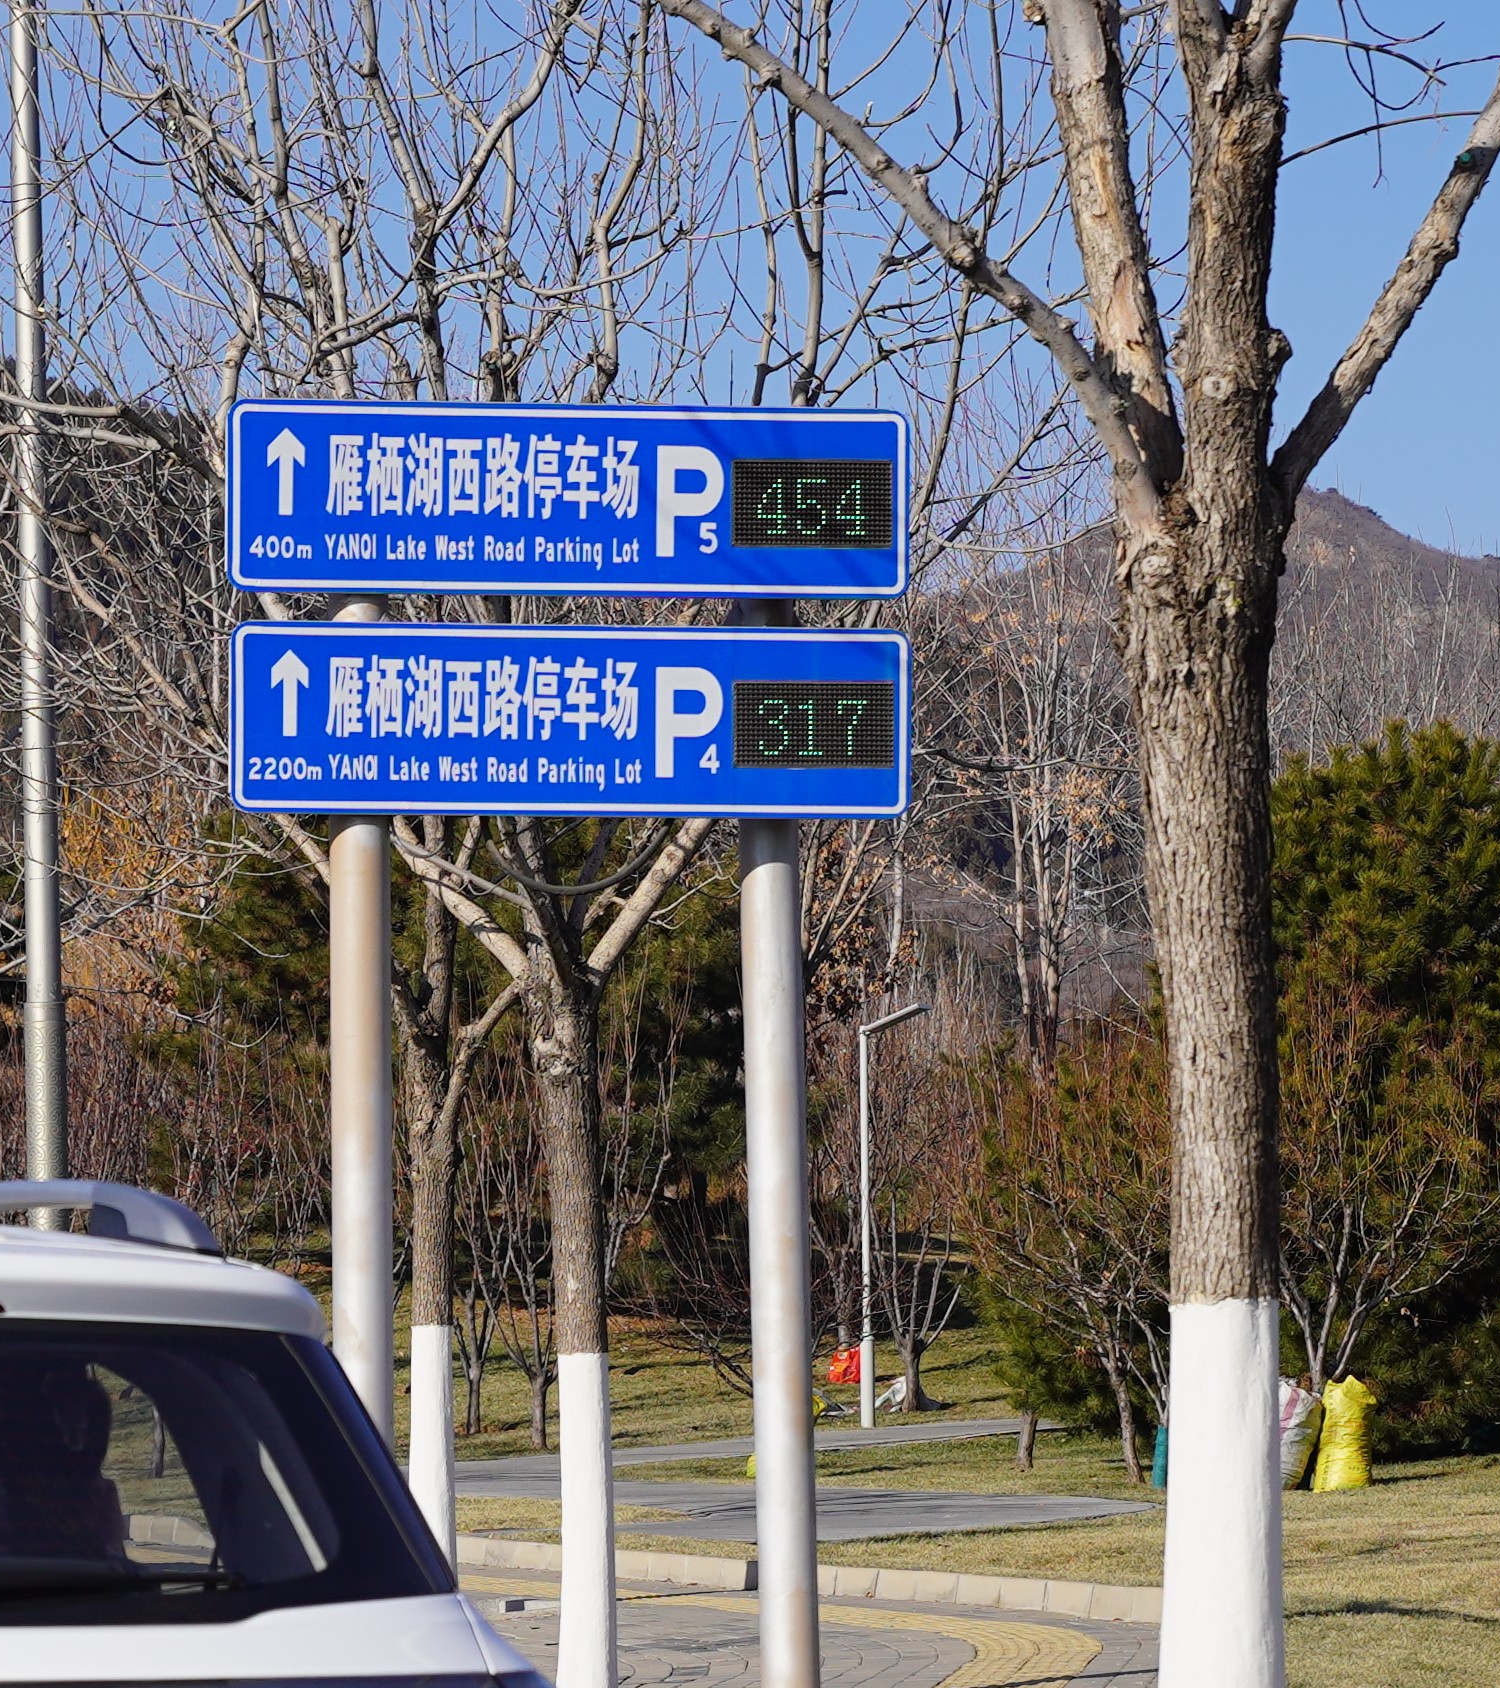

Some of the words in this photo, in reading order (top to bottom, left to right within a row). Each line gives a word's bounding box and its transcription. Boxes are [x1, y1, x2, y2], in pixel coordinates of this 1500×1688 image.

[325, 432, 640, 520] 雁栖湖西路停车场
[756, 478, 866, 536] 454
[248, 534, 313, 560] 400m
[324, 533, 377, 560] YANQI
[386, 533, 427, 561] Lake
[435, 534, 475, 562] West
[483, 535, 525, 562] Road
[534, 536, 603, 571] Parking
[612, 537, 639, 564] Lot
[325, 654, 639, 741] 雁栖湖西路停车场
[758, 699, 867, 756] 317
[247, 756, 323, 782] 2200m
[328, 753, 378, 781] YANQI
[389, 754, 430, 782] Lake
[438, 755, 478, 783] West
[486, 756, 528, 784] Road
[537, 756, 605, 792] Parking
[614, 757, 642, 785] Lot
